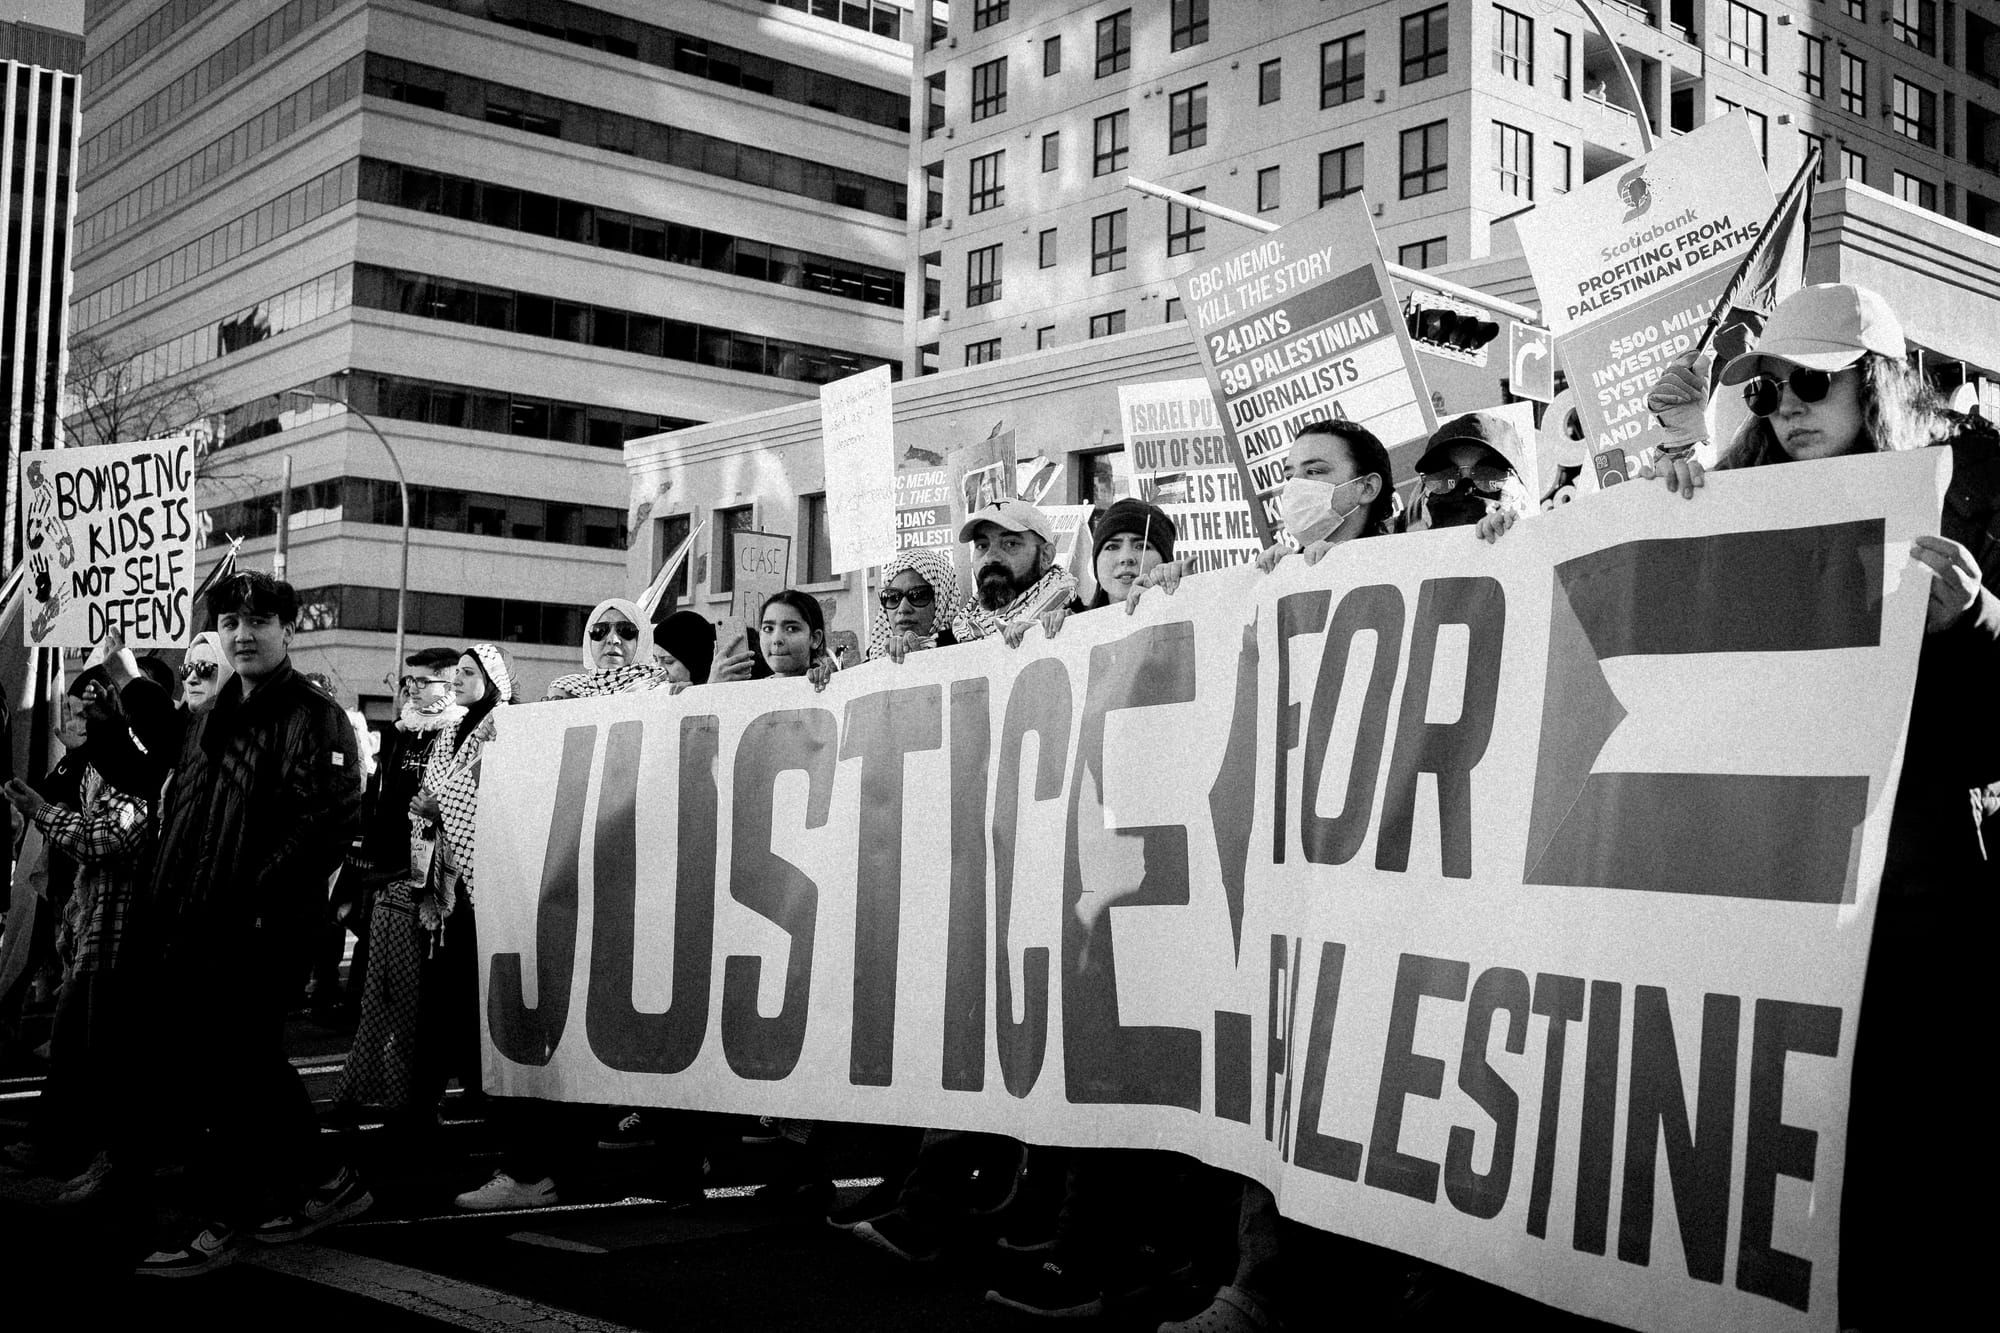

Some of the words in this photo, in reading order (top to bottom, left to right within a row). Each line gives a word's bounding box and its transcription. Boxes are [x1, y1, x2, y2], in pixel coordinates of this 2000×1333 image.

[1578, 243, 1673, 296] PROFITING
[1676, 215, 1732, 252] FROM
[1601, 208, 1699, 262] Scotiabank
[1189, 267, 1223, 301] CBC
[1225, 240, 1286, 286] MEMO:
[1198, 294, 1236, 328] KILL
[1236, 274, 1273, 310] THE
[1274, 246, 1332, 294] STORY
[1567, 258, 1682, 320] PALESTINIAN
[1685, 221, 1761, 267] DEATHS
[1210, 330, 1243, 362] 24
[1239, 310, 1291, 350] DAYS
[1220, 363, 1252, 396] 39
[1251, 309, 1380, 383] PALESTINIAN
[1610, 326, 1658, 360] $500
[1662, 294, 1723, 336] MILLI
[1592, 334, 1690, 388] INVESTED
[1129, 401, 1188, 432] ISRAEL
[1189, 398, 1220, 427] PU
[1232, 357, 1359, 427] JOURNALISTS
[1134, 439, 1166, 469] OUT
[1170, 438, 1189, 467] OF
[1243, 424, 1283, 459] AND
[1599, 420, 1642, 451] AND
[55, 445, 191, 520] BOMBING
[906, 470, 947, 489] MEMO:
[910, 489, 933, 505] THE
[1198, 474, 1216, 503] IS
[89, 507, 154, 563] KIDS
[161, 497, 191, 542] IS
[904, 510, 936, 528] DAYS
[904, 528, 953, 548] PALESTI
[1190, 511, 1222, 540] THE
[72, 565, 115, 598] NOT
[122, 549, 183, 596] SELF
[741, 547, 781, 575] CEASE
[1273, 576, 1506, 880] FOR
[1265, 934, 1843, 1313] PALESTINE
